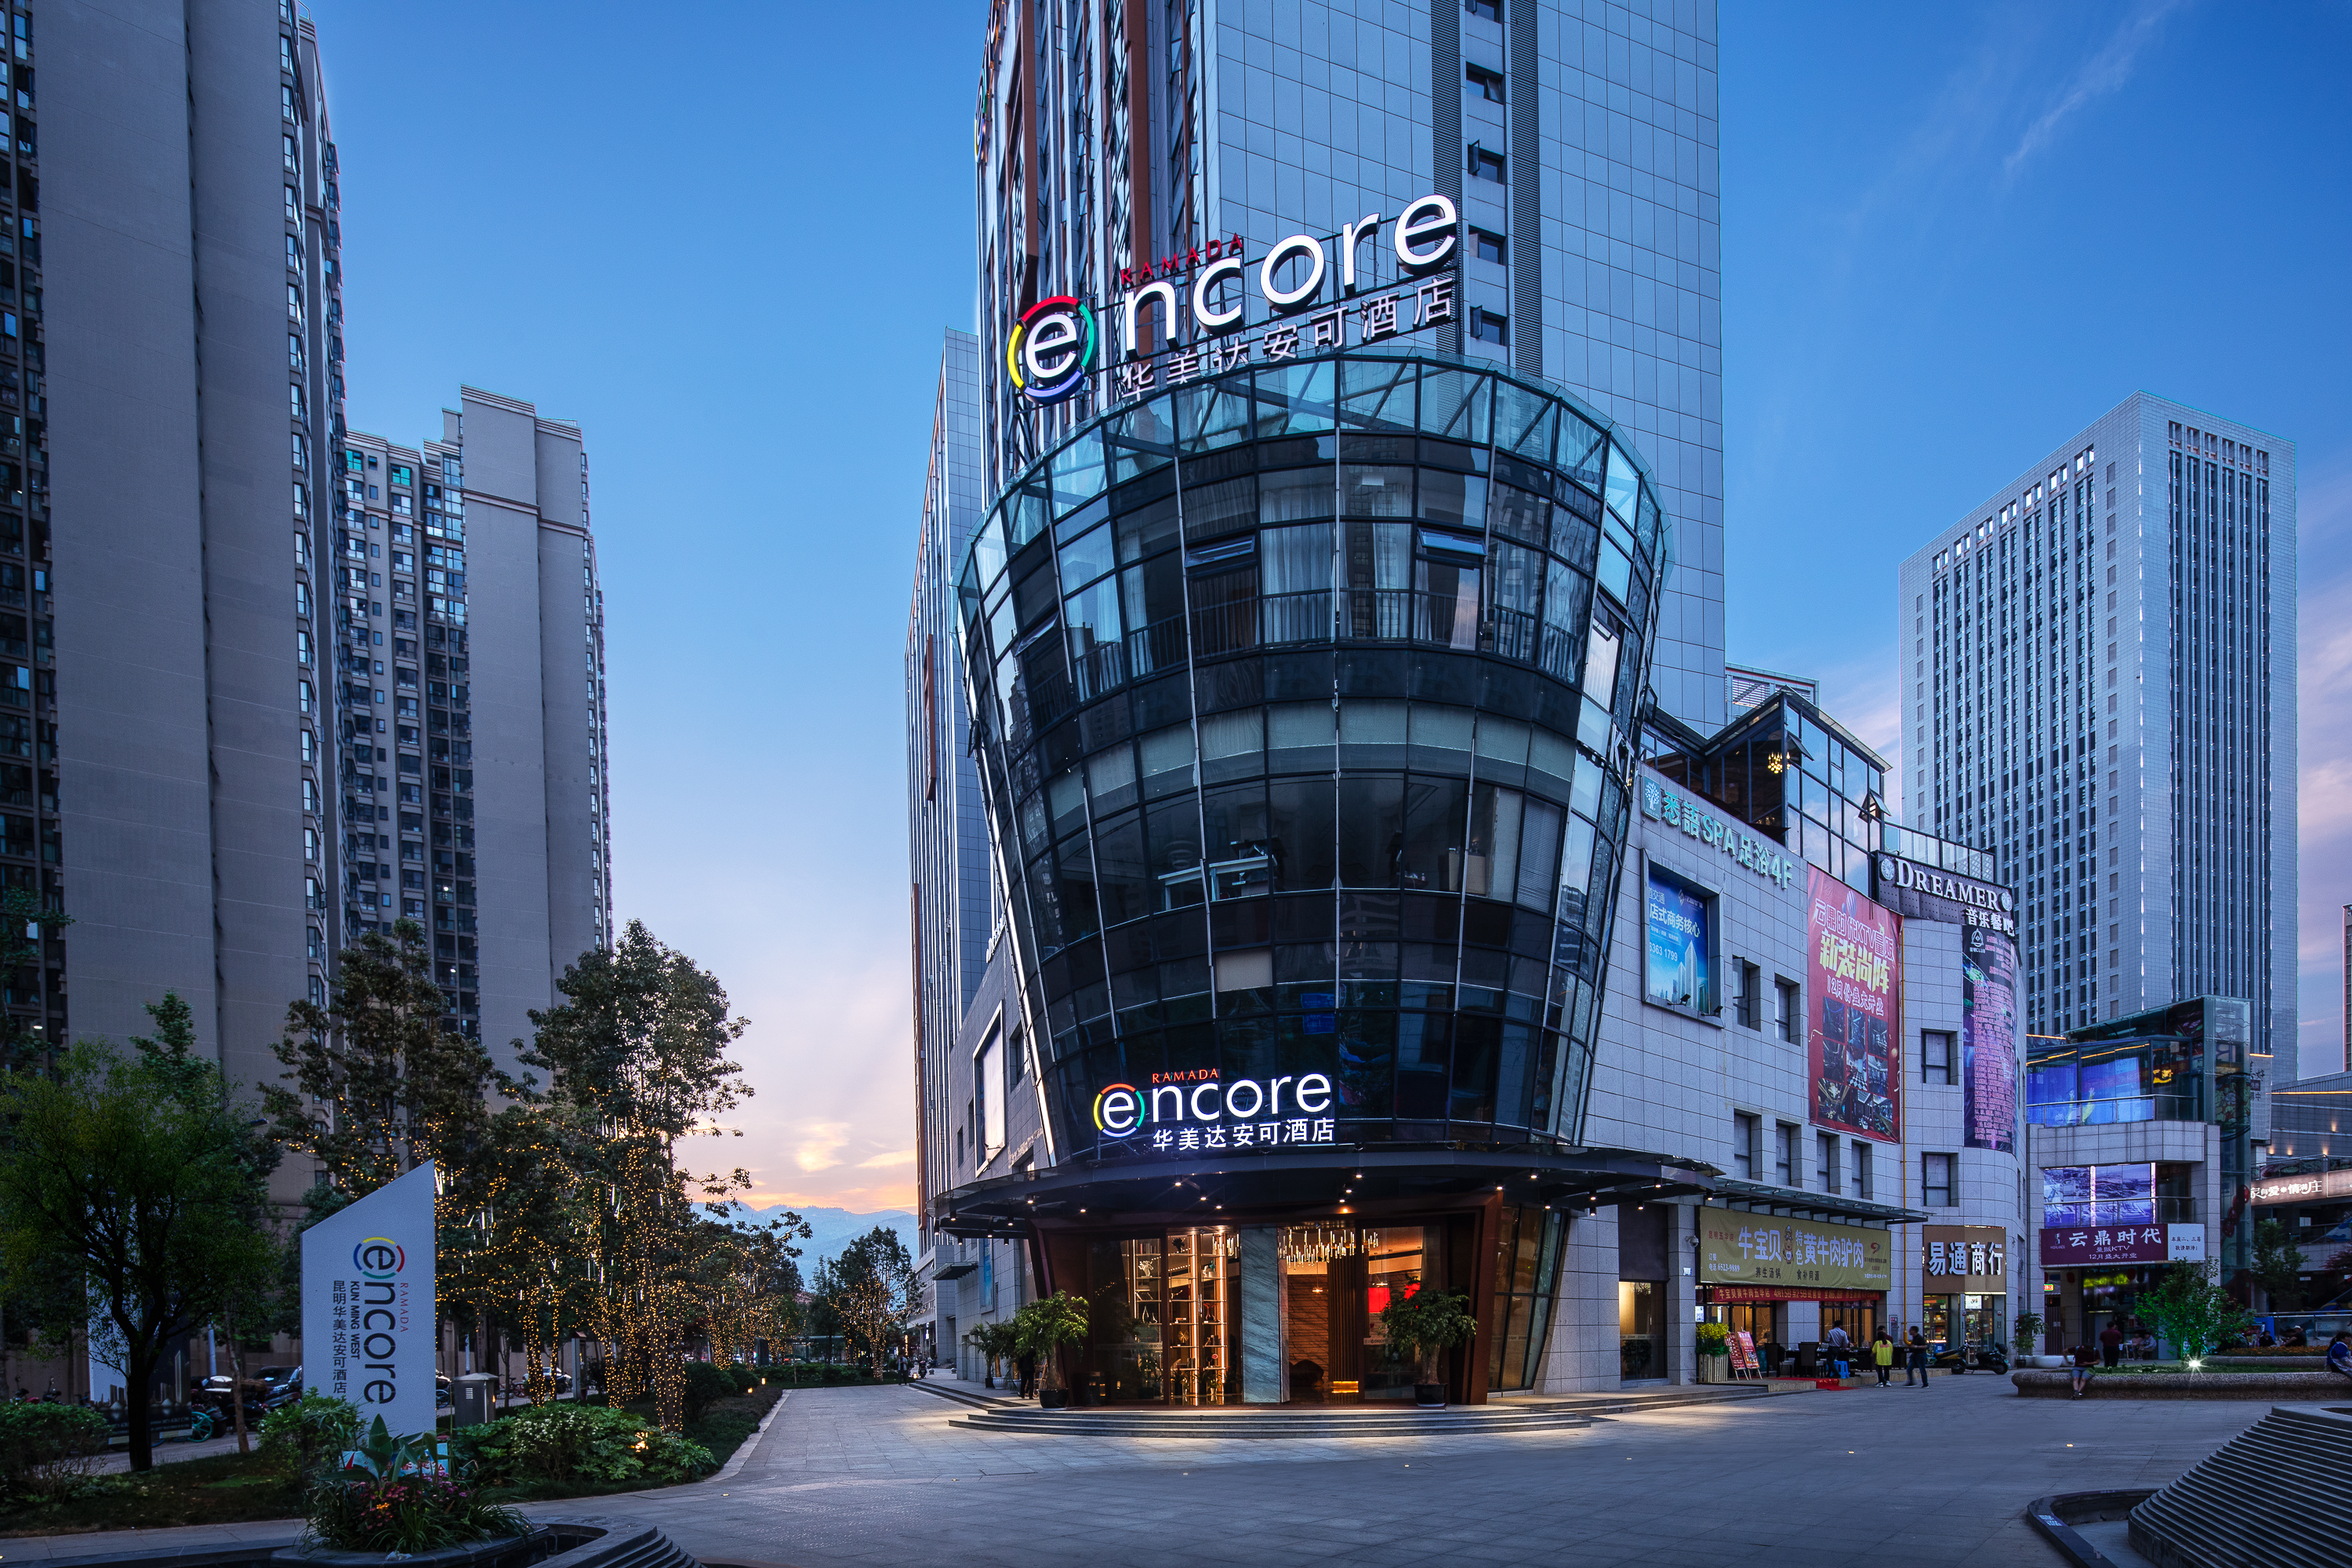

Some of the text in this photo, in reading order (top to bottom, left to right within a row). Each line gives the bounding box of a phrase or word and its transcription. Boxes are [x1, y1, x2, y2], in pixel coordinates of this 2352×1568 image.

[1121, 233, 1244, 285] RAMADA
[1024, 194, 1457, 381] encore
[1120, 277, 1454, 401] 华美达安可酒店
[1896, 858, 2001, 912] DREAMER
[1965, 906, 2015, 937] 音乐餐吧
[1664, 948, 1678, 962] 1799
[1819, 927, 1890, 995] 新装尚阵
[1103, 1073, 1331, 1129] encore
[1152, 1068, 1218, 1083] RAMADA
[1152, 1118, 1334, 1152] 华美达安可酒店
[1738, 1225, 1782, 1261] 牛宝贝
[1929, 1241, 2003, 1276] 易通商行
[2069, 1228, 2162, 1247] 云鼎时代
[350, 1280, 360, 1359] KUN MING WEST
[362, 1245, 396, 1404] encore
[400, 1283, 409, 1333] RAMADA
[332, 1279, 347, 1394] 昆明华美达安可酒店
